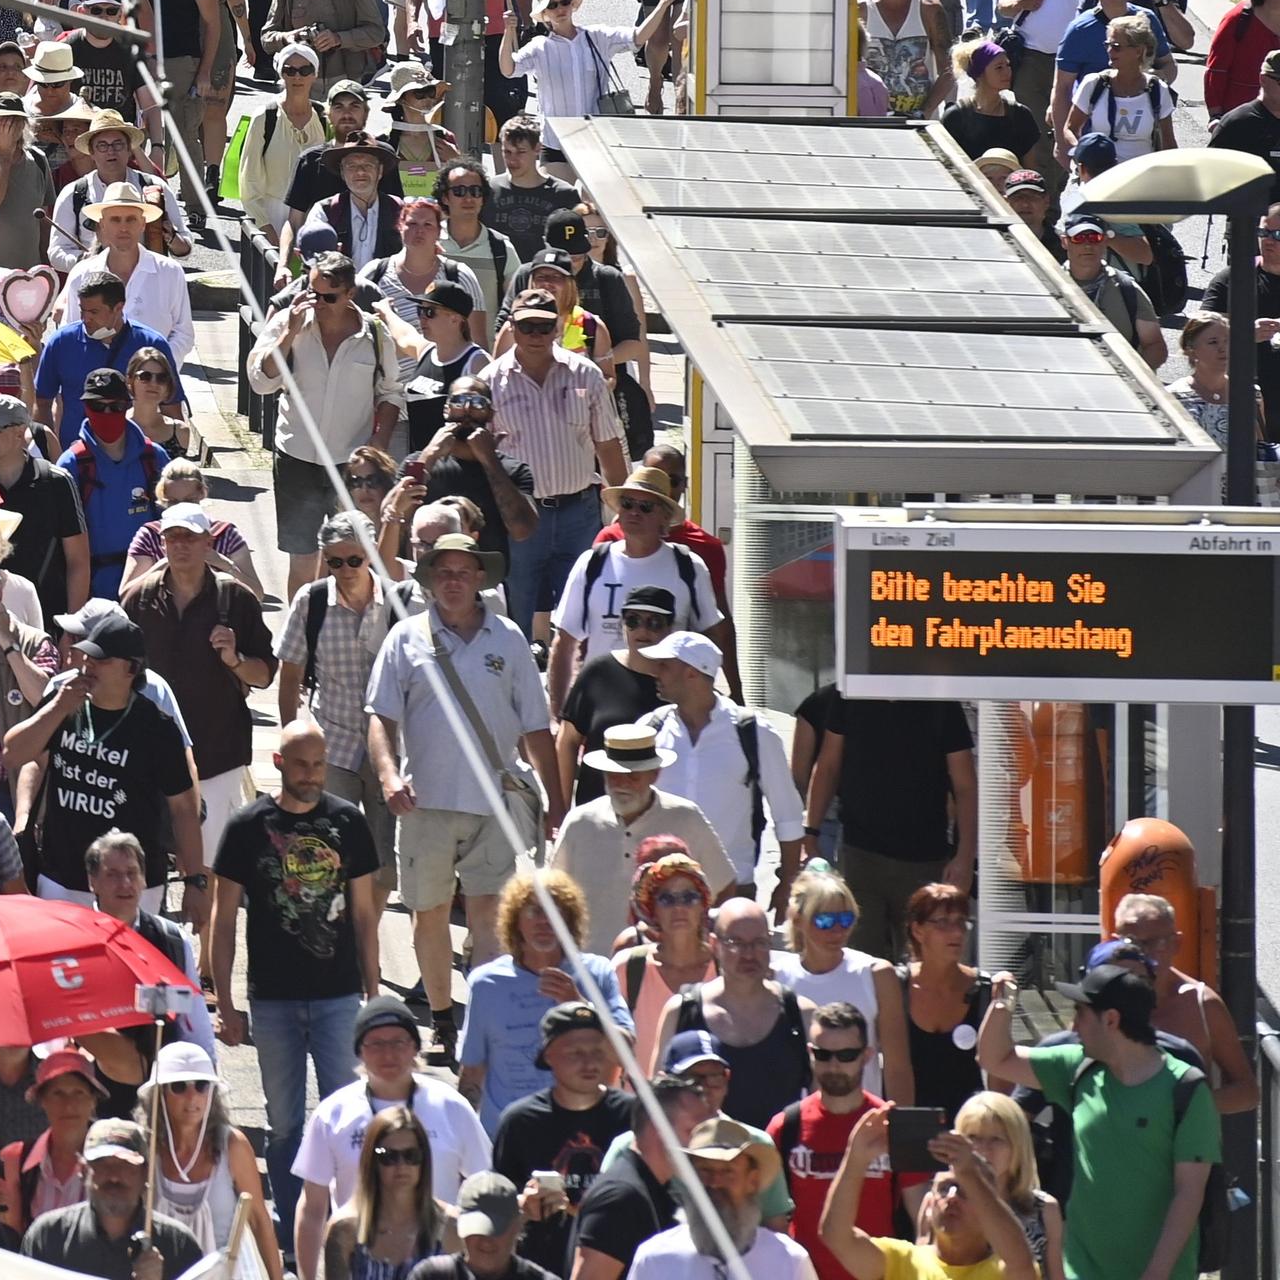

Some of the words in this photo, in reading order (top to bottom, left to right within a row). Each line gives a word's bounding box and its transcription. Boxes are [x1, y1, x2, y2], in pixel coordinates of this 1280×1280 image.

[564, 225, 575, 240] P
[871, 531, 910, 547] Linie
[925, 531, 956, 548] Ziel
[1189, 534, 1250, 554] Abfahrt
[1256, 534, 1272, 554] in
[870, 570, 930, 604] Bitte
[941, 573, 1050, 605] beachten
[1067, 575, 1106, 606] Sie
[870, 617, 912, 648] den
[925, 619, 1133, 658] Fahrplanaushang
[59, 729, 130, 769] Merkel
[61, 761, 81, 782] ist
[84, 768, 119, 793] der
[56, 787, 117, 820] VIRUS
